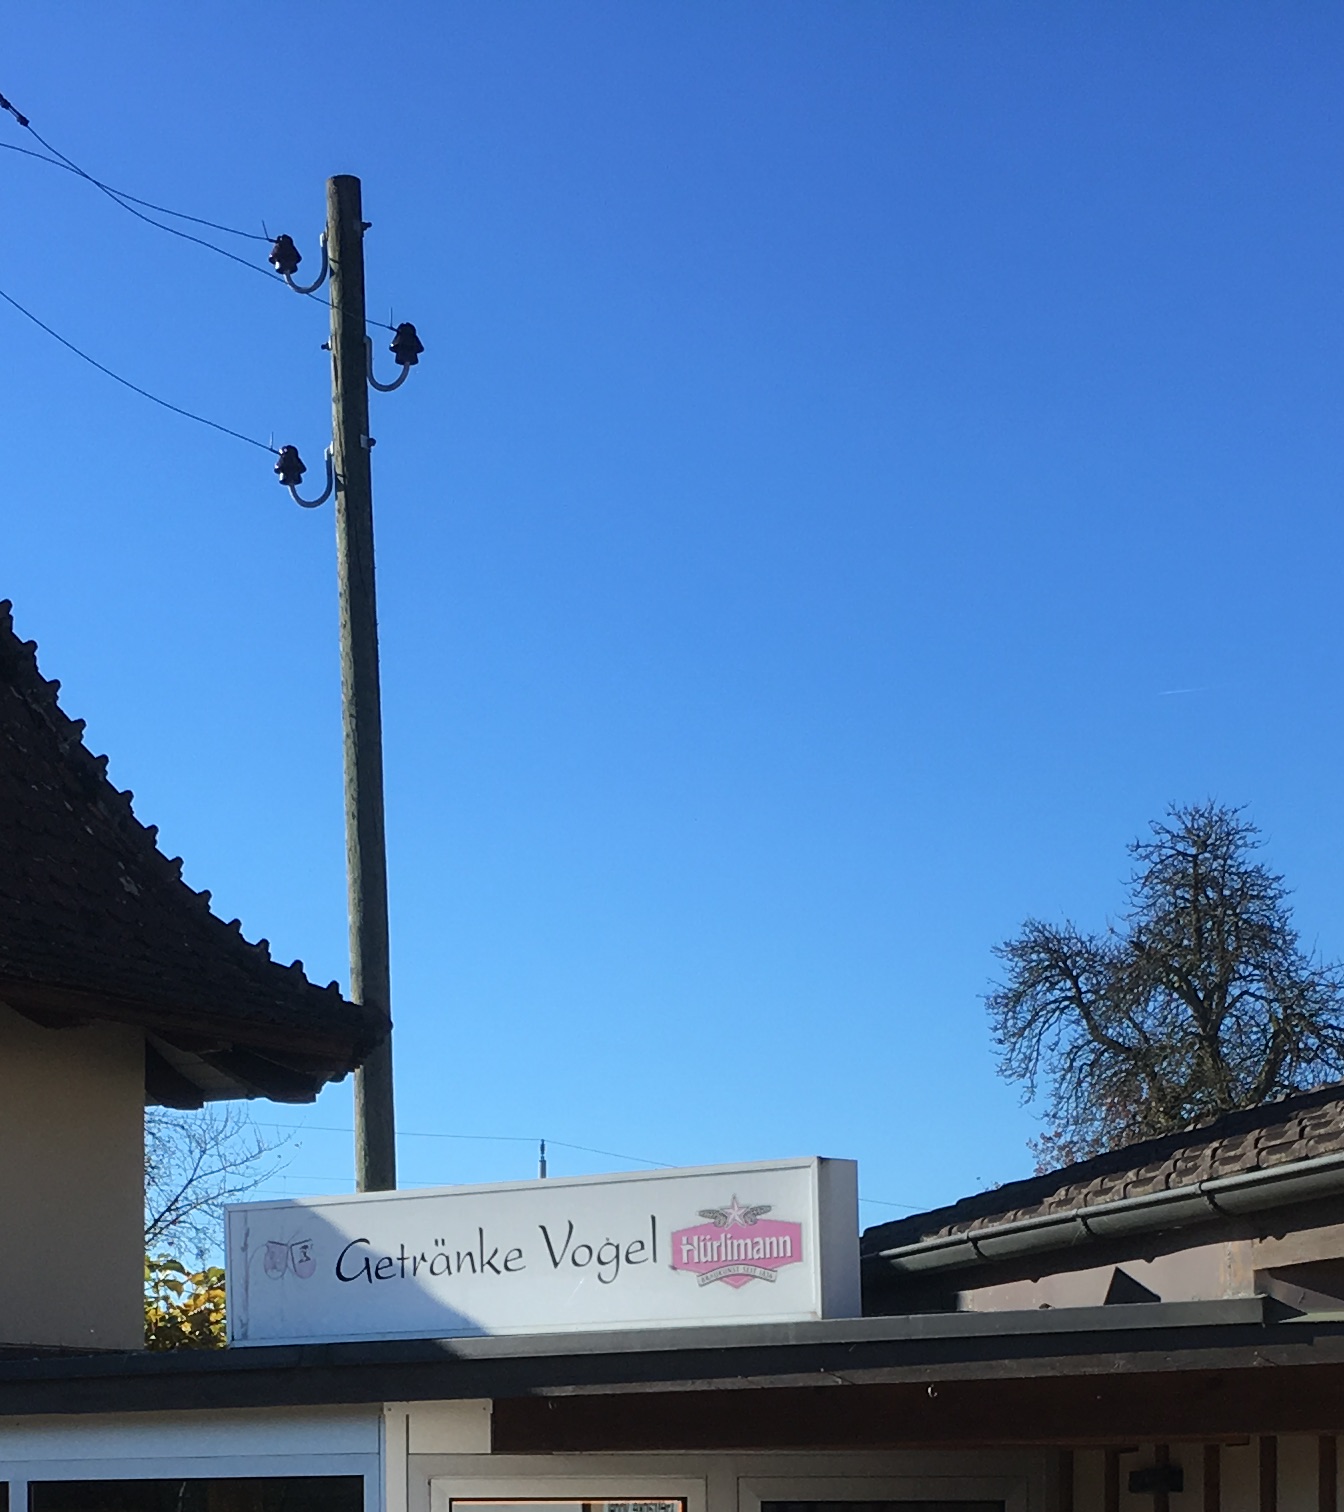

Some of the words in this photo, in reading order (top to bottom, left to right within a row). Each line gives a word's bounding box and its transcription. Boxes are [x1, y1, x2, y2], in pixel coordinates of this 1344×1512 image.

[335, 1226, 527, 1285] Getränke
[538, 1214, 658, 1285] Vogel
[680, 1232, 793, 1265] Hürlimann
